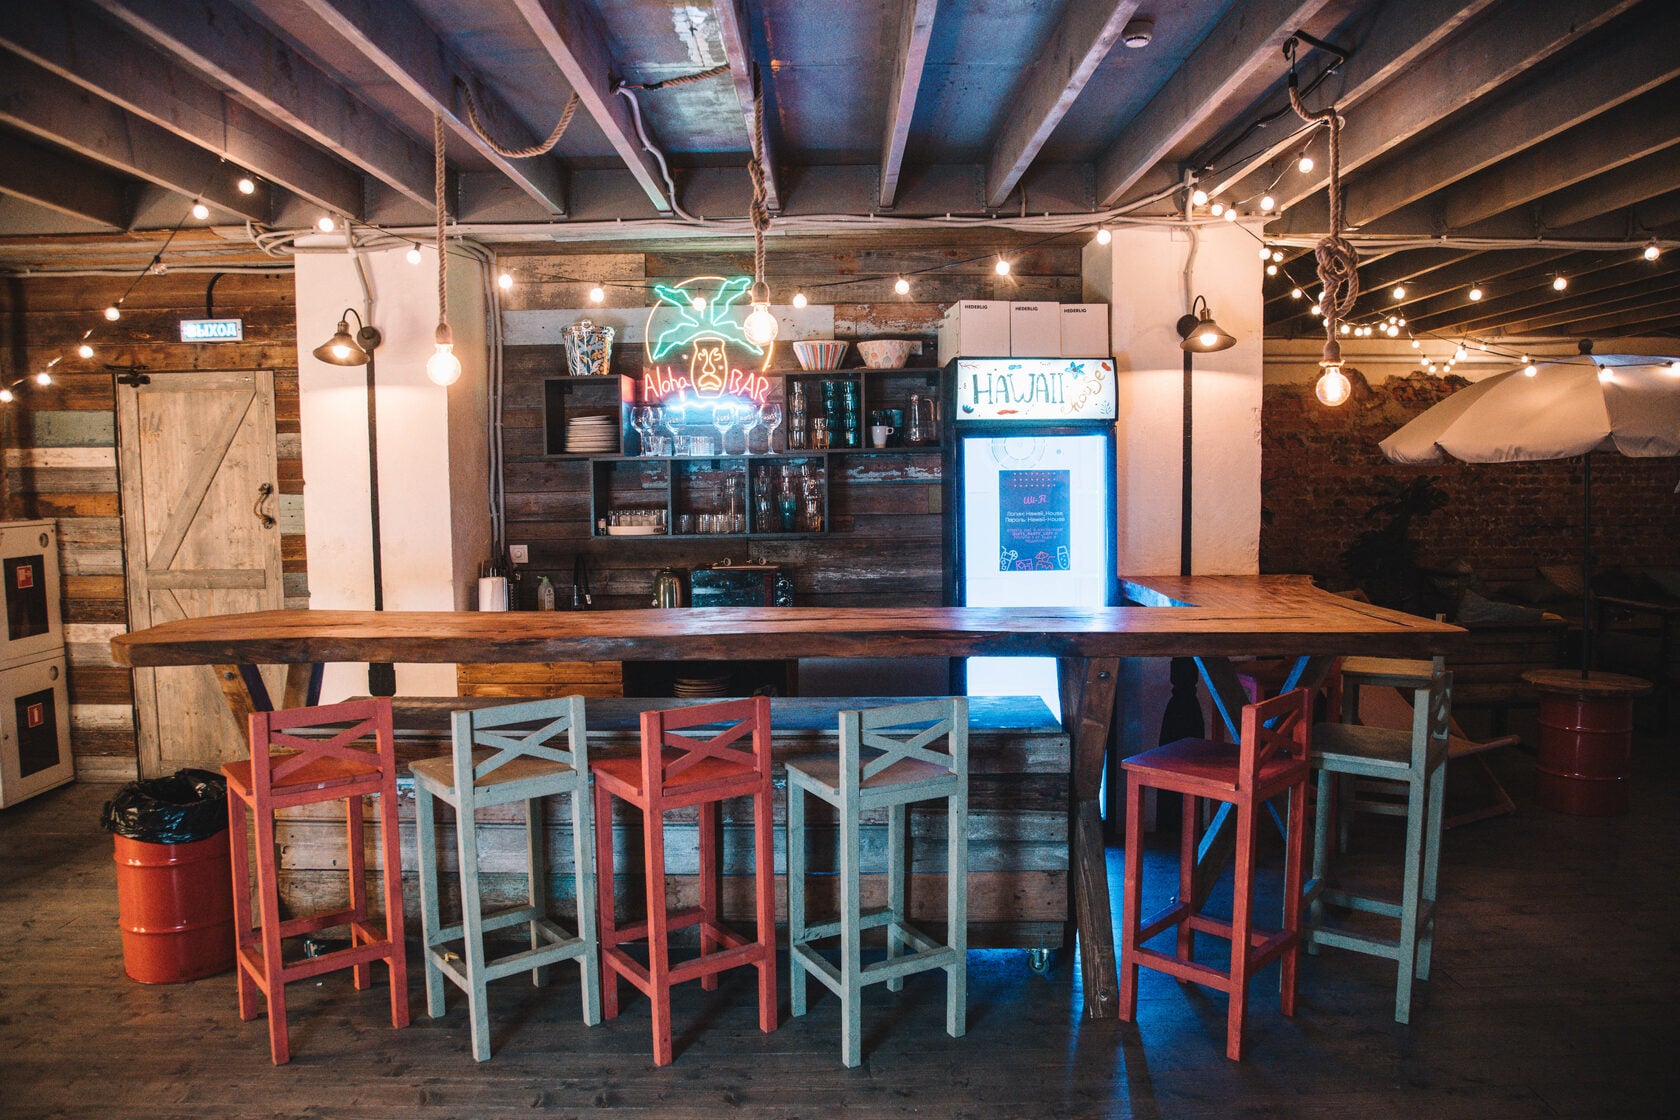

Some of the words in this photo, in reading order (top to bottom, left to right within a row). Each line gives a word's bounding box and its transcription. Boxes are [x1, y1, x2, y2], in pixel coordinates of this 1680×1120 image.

[186, 322, 237, 338] ВЫХОД
[644, 366, 692, 402] Aloha
[729, 369, 769, 403] BAR
[972, 373, 1066, 405] HAWAII
